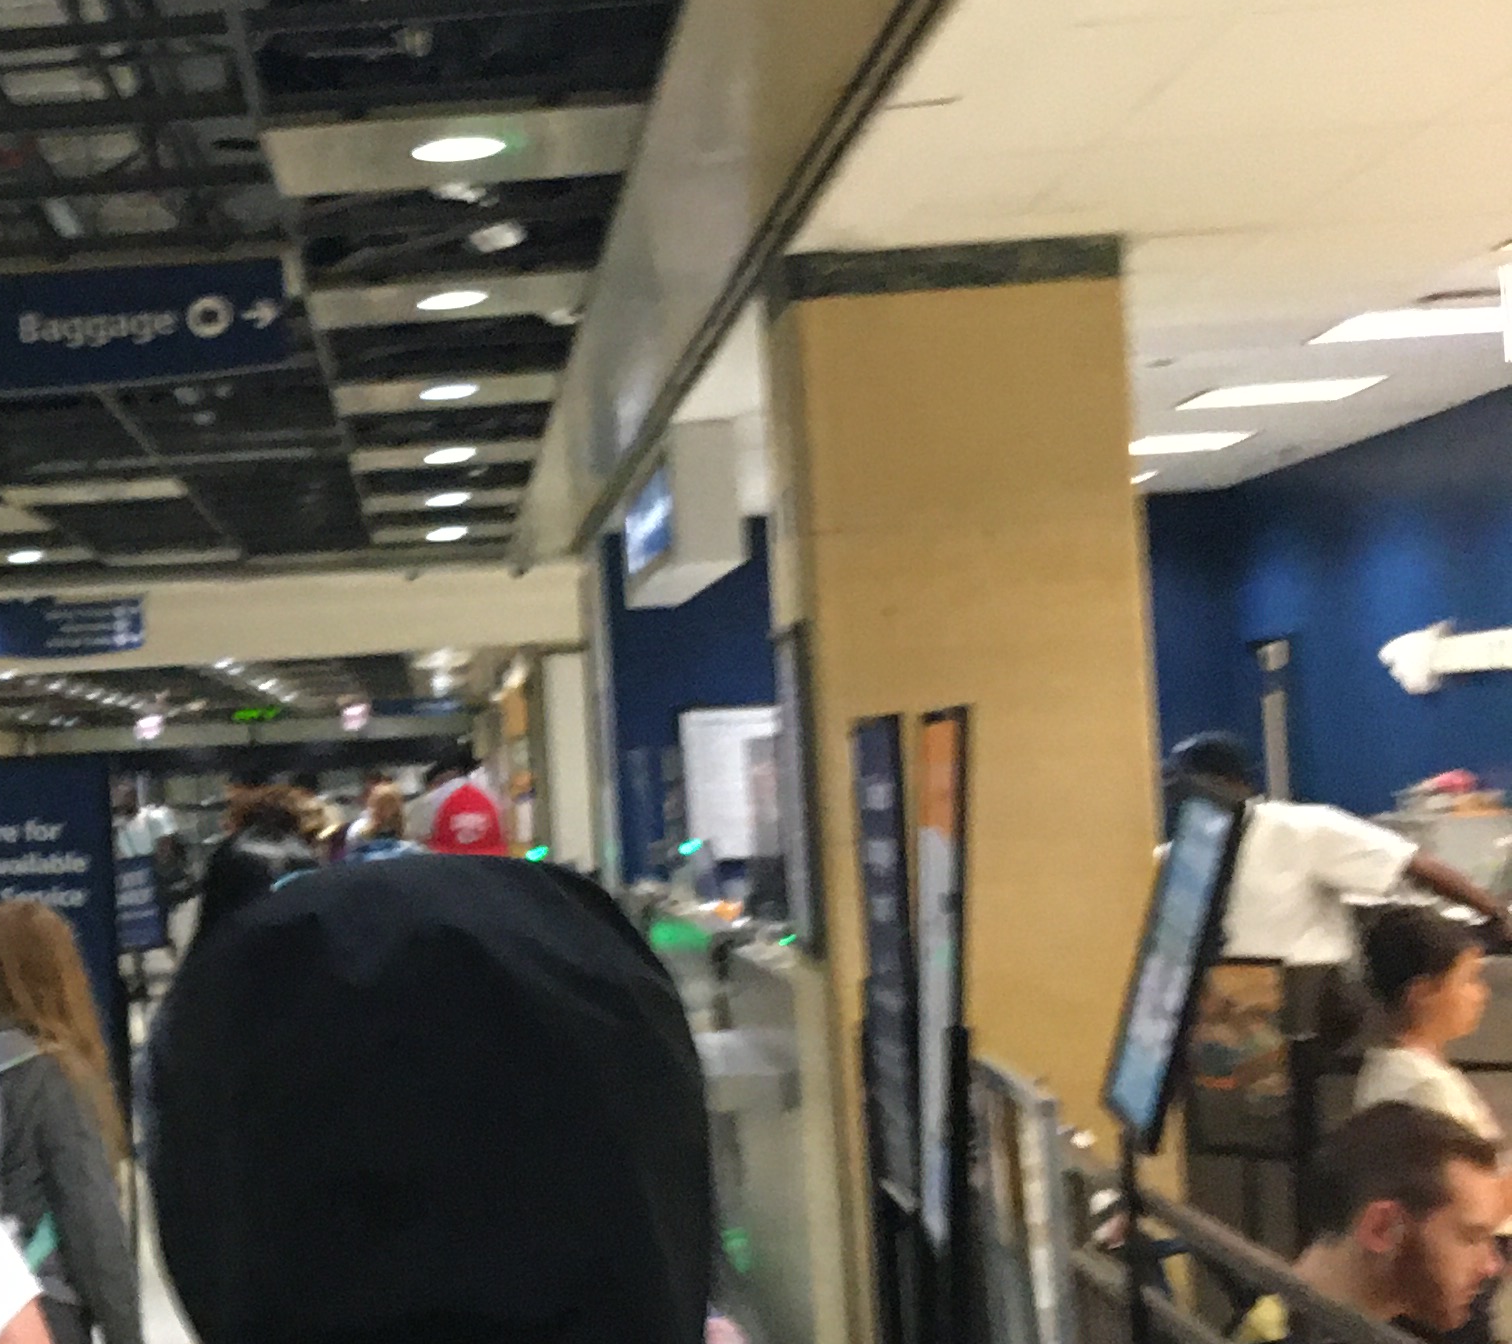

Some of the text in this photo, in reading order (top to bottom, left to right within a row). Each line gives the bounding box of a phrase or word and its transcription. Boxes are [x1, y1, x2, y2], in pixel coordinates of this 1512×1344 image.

[19, 311, 175, 347] Baggage
[24, 817, 64, 842] for
[0, 885, 88, 907] Service
